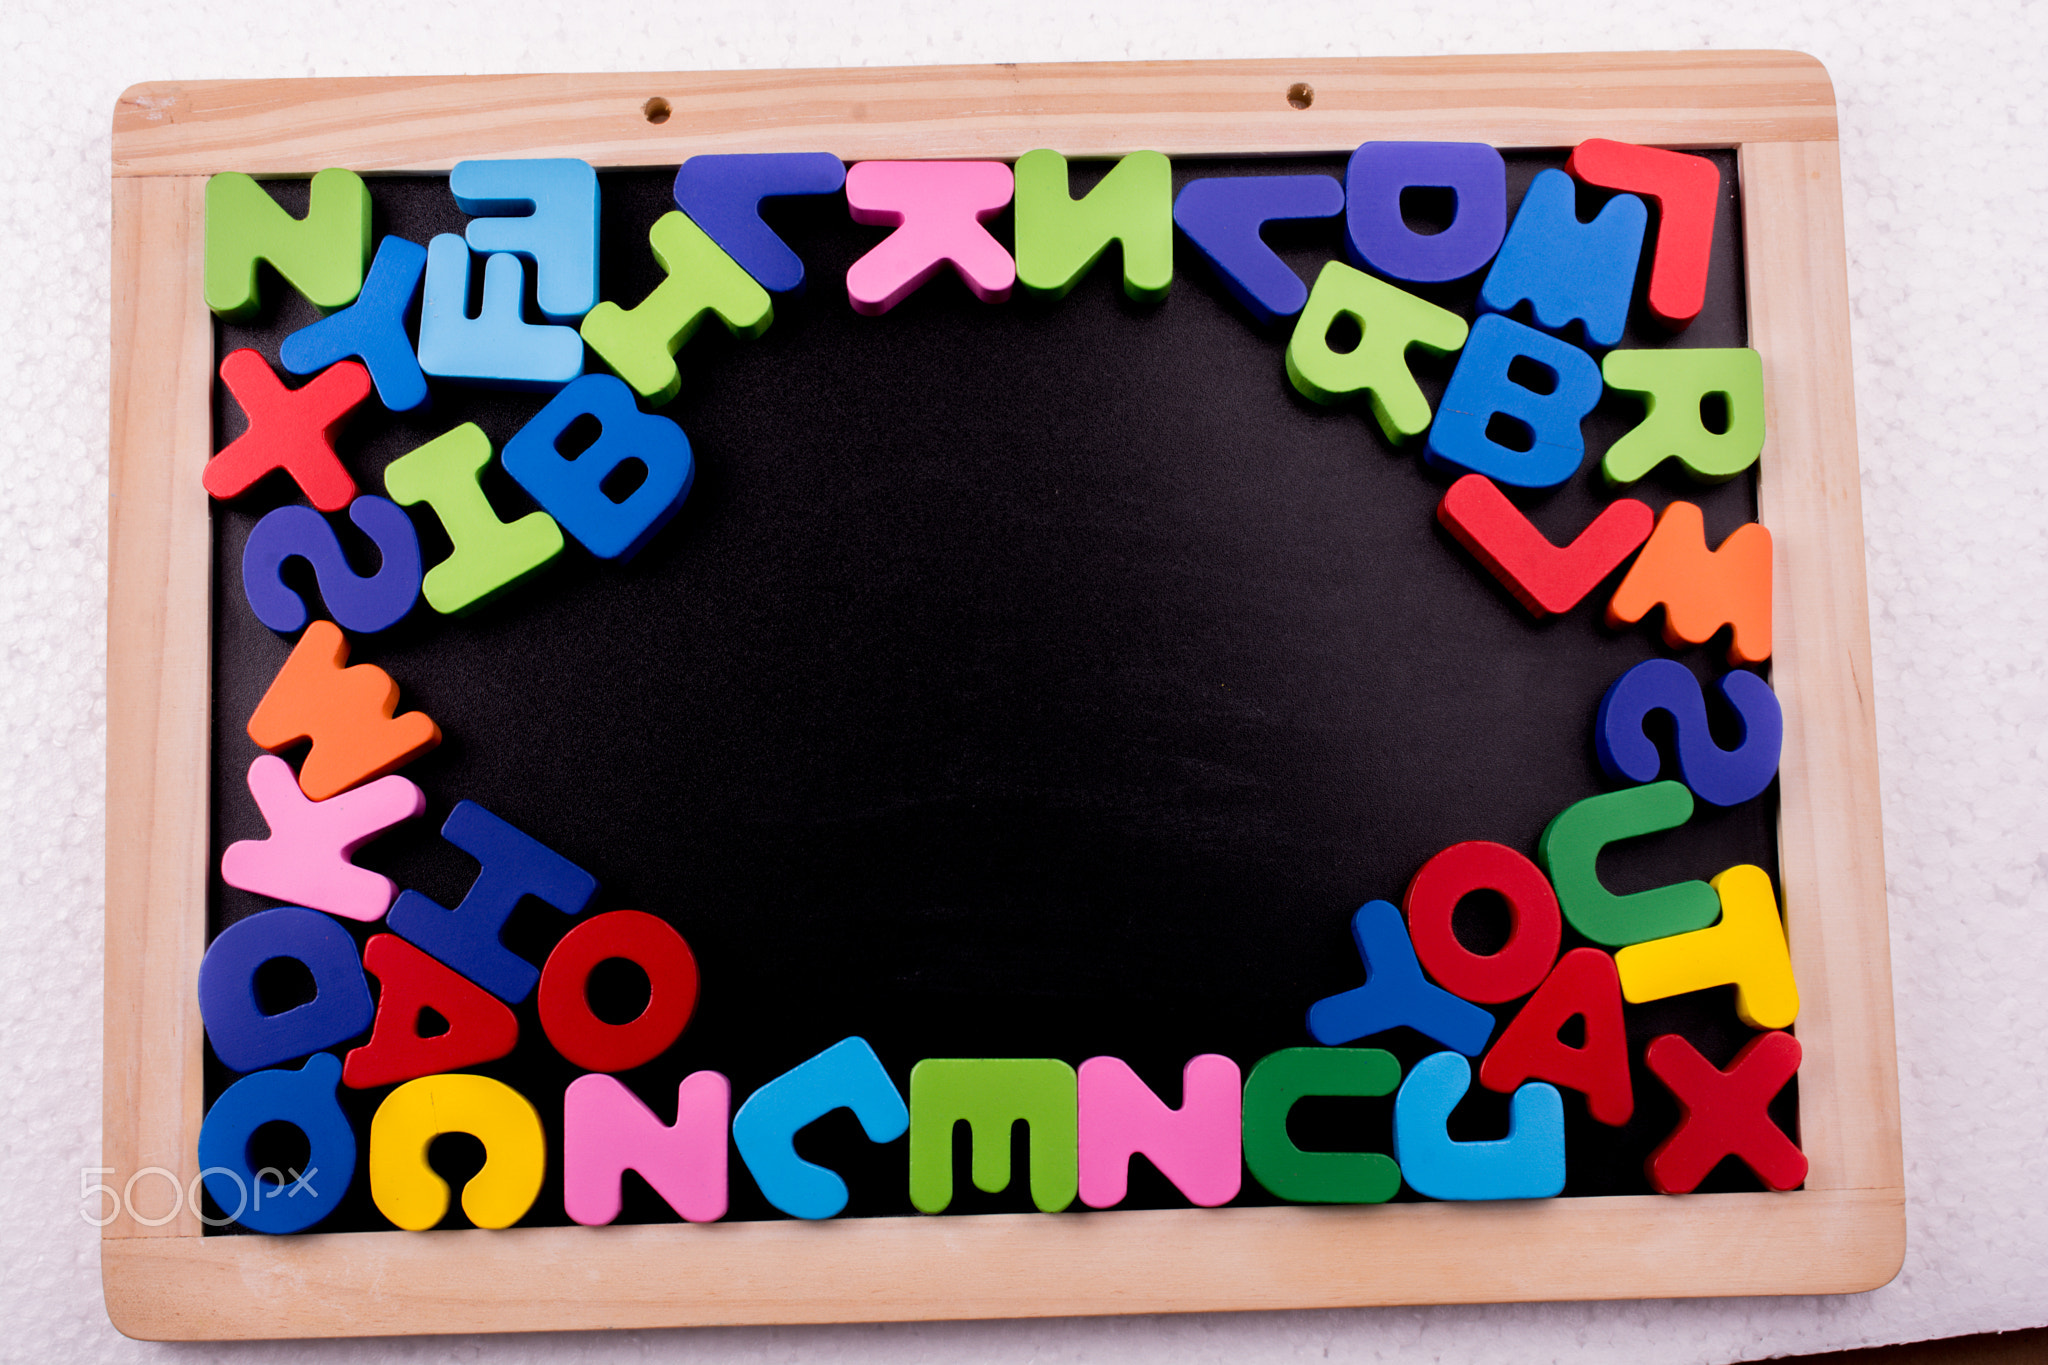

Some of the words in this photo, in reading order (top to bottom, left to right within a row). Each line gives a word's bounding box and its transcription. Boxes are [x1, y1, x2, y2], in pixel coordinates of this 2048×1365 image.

[205, 168, 371, 319] N
[845, 161, 1016, 316] K
[1344, 141, 1507, 284] D
[280, 235, 428, 411] Y
[1424, 313, 1602, 491] B
[202, 349, 371, 512] X
[501, 373, 694, 562] B
[1602, 348, 1767, 489] R
[221, 755, 426, 922] K
[198, 906, 375, 1072] D
[538, 909, 699, 1072] O
[1306, 900, 1496, 1058] Y
[1404, 840, 1562, 1005] O
[1614, 864, 1800, 1032] T
[341, 932, 518, 1089] A
[1480, 948, 1634, 1127] A
[563, 1070, 731, 1226] N
[1077, 1053, 1241, 1208] N
[1645, 1030, 1808, 1195] X
